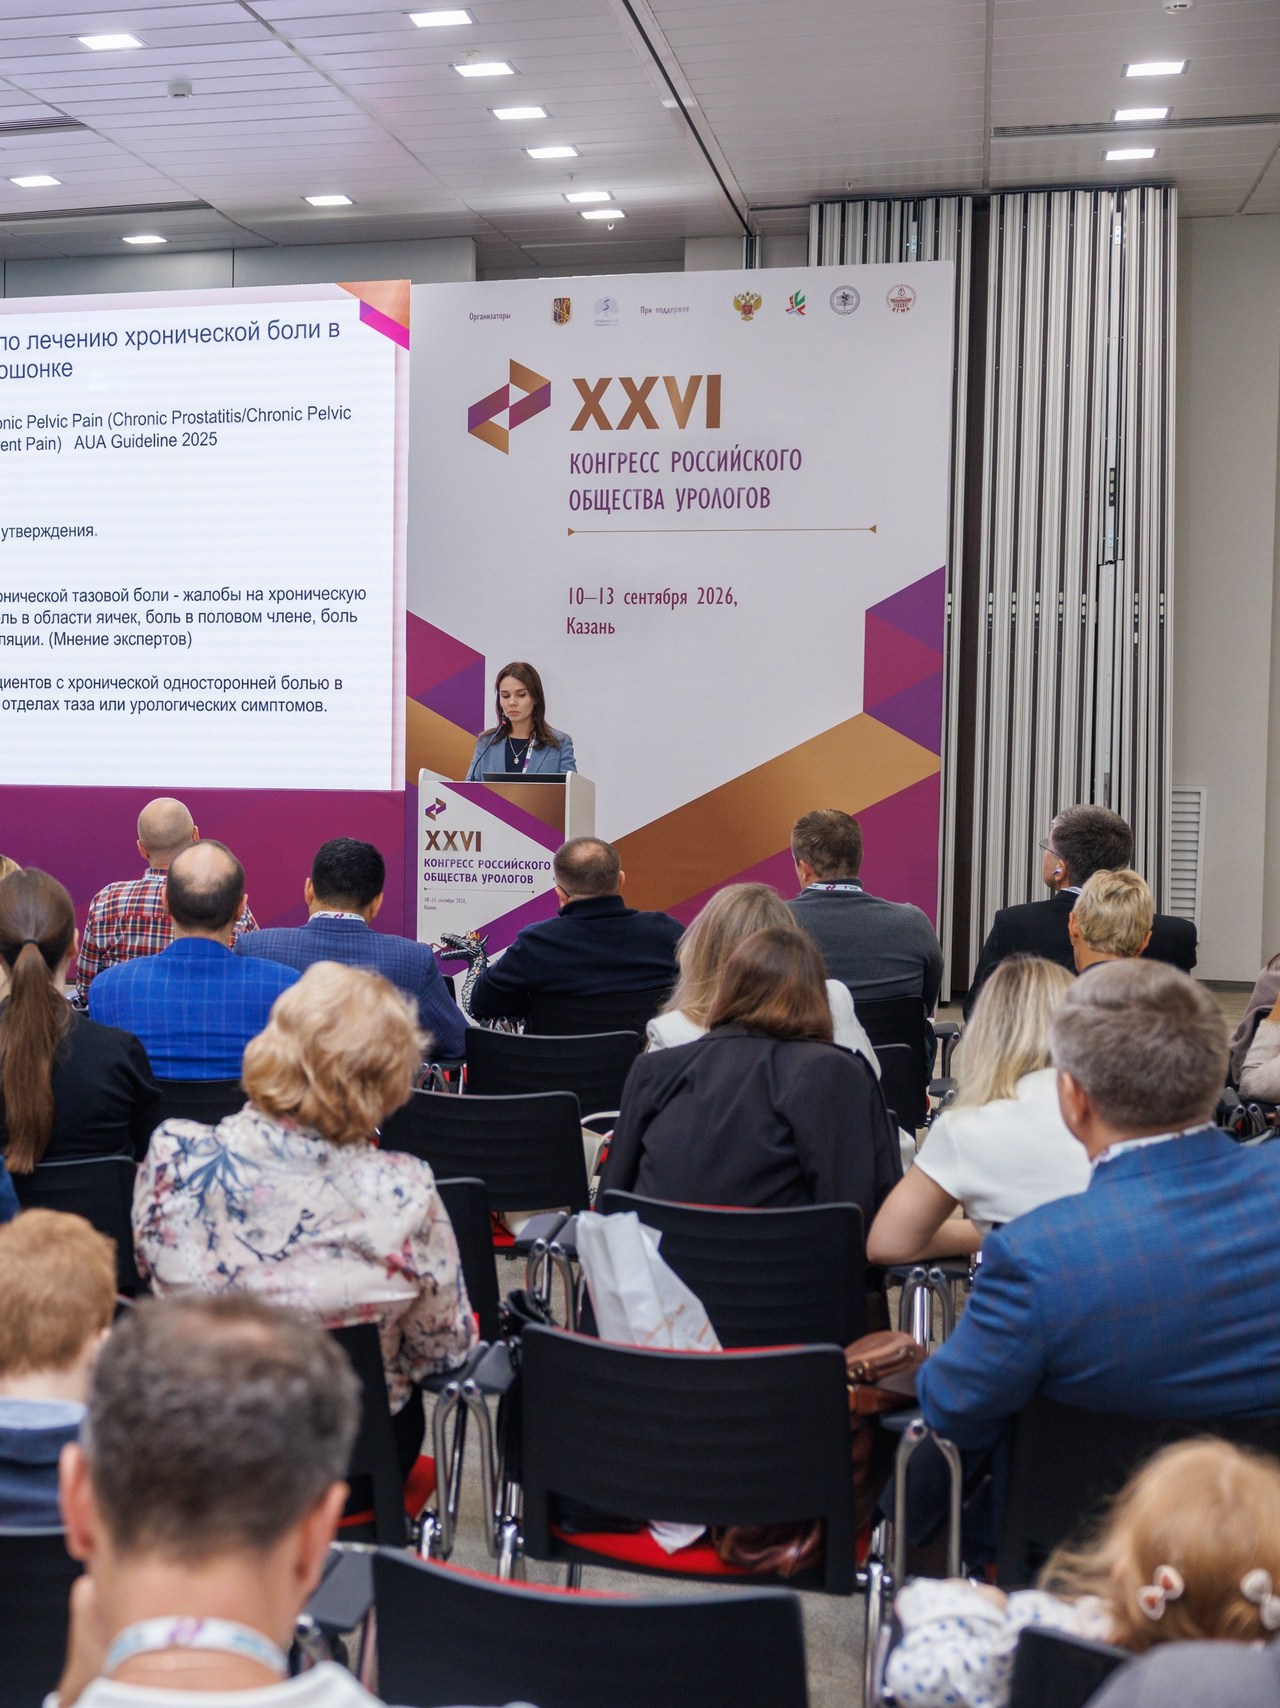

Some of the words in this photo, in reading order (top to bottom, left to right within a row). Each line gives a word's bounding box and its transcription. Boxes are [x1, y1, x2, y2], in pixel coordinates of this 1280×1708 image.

[468, 312, 511, 322] Организаторы
[639, 305, 652, 316] При
[655, 306, 689, 315] поддержке
[26, 331, 118, 350] лечению
[124, 320, 259, 351] хронической
[267, 318, 320, 340] боли
[328, 322, 340, 338] в
[569, 373, 722, 431] XXVI
[26, 413, 68, 429] Pelvic
[72, 412, 103, 428] Pain
[107, 410, 167, 430] (Chronic
[171, 406, 302, 425] Prostatitis/Chronic
[307, 404, 351, 421] Pelvic
[26, 435, 61, 453] Pain)
[73, 434, 107, 449] AUA
[110, 432, 177, 449] Guideline
[181, 431, 217, 447] 2025
[570, 451, 659, 474] КОНГРЕСС
[671, 443, 802, 472] РОССИЙСКОГО
[568, 487, 665, 515] ОБЩЕСТВА
[675, 486, 770, 512] УРОЛОГОВ
[0, 525, 97, 542] утверждения.
[71, 587, 129, 603] тазовой
[133, 586, 169, 602] боли
[182, 586, 241, 601] жалобы
[246, 589, 263, 601] на
[267, 588, 366, 604] хроническую
[569, 586, 614, 605] 10–13
[623, 587, 687, 610] сентября
[696, 586, 737, 607] 2026,
[21, 613, 30, 624] в
[33, 609, 92, 624] области
[95, 612, 140, 626] яичек,
[145, 608, 181, 624] боль
[185, 612, 193, 623] в
[198, 611, 262, 623] половом
[266, 611, 315, 625] члене,
[320, 607, 358, 623] боль
[566, 616, 615, 634] Казань
[48, 631, 109, 649] (Мнение
[113, 630, 192, 649] экспертов)
[55, 677, 64, 689] с
[67, 674, 158, 692] хронической
[162, 674, 276, 693] односторонней
[280, 674, 329, 690] болью
[334, 678, 343, 690] в
[1, 699, 60, 713] отделах
[63, 699, 95, 711] таза
[99, 699, 125, 711] или
[129, 699, 237, 715] урологических
[240, 700, 327, 712] симптомов.
[424, 829, 481, 852] XXVI
[423, 858, 474, 868] КОНГРЕСС
[477, 857, 551, 870] РОССИЙСКОГО
[423, 872, 478, 883] ОБЩЕСТВА
[481, 873, 534, 885] УРОЛОГОВ
